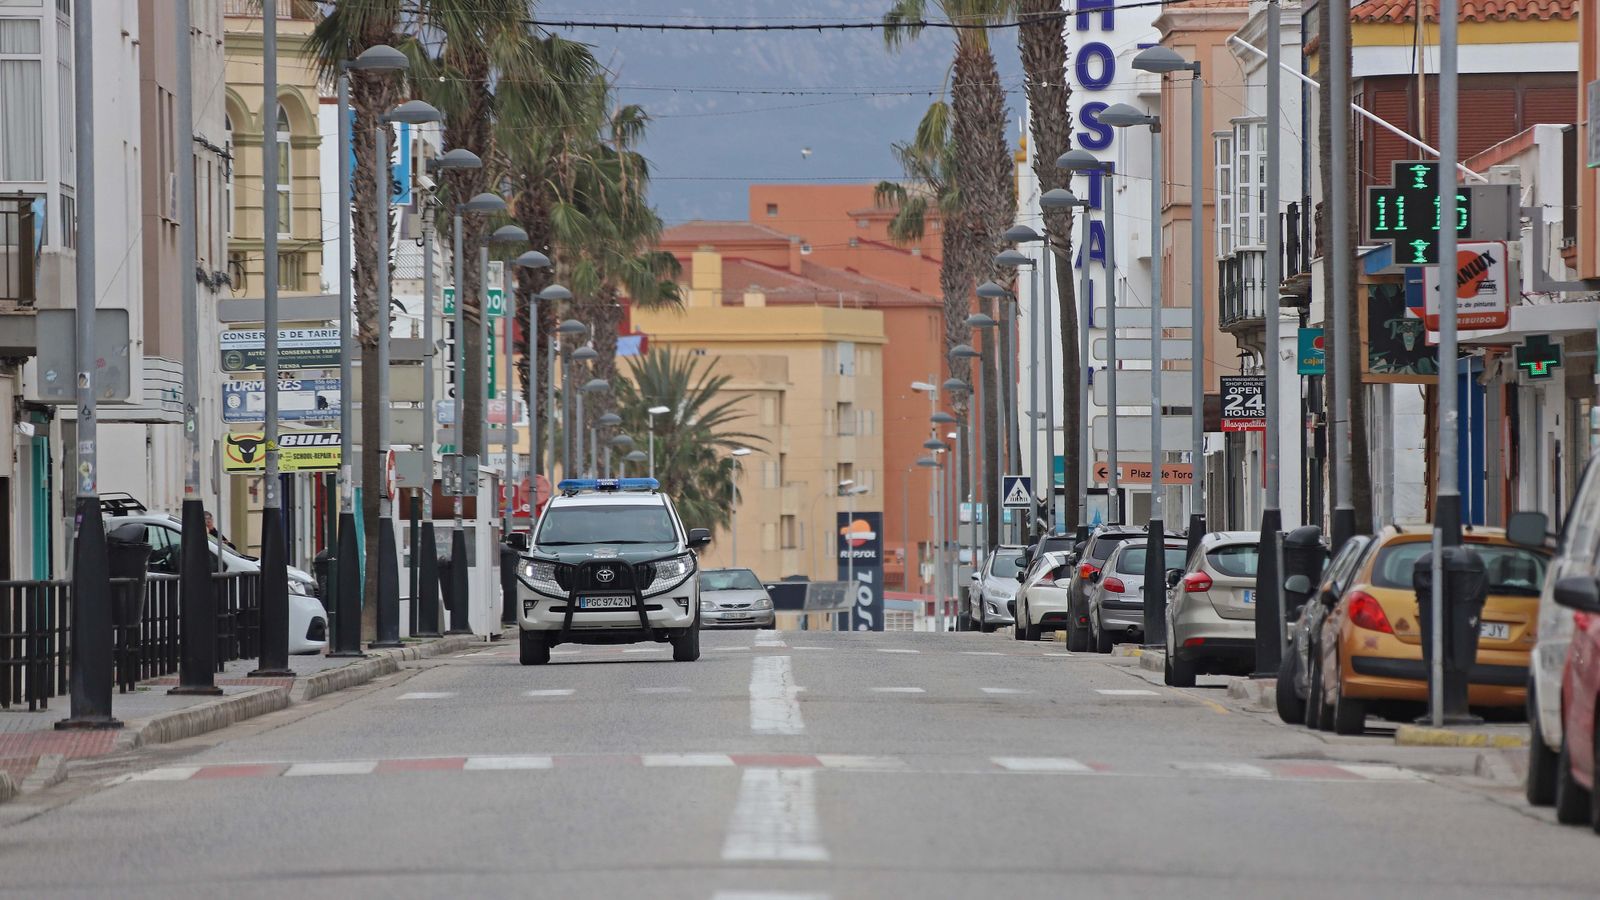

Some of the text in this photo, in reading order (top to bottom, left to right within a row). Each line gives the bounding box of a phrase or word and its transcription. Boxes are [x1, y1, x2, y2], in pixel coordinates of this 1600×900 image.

[1457, 316, 1497, 325] RIBUIDOR
[223, 331, 286, 340] CONSERS
[290, 330, 303, 338] DE
[223, 380, 302, 392] TURMRES
[1229, 386, 1261, 394] OPEN
[1224, 394, 1266, 410] 24
[280, 434, 341, 446] BULL
[1130, 469, 1152, 479] Plaz
[857, 570, 873, 631] SOL
